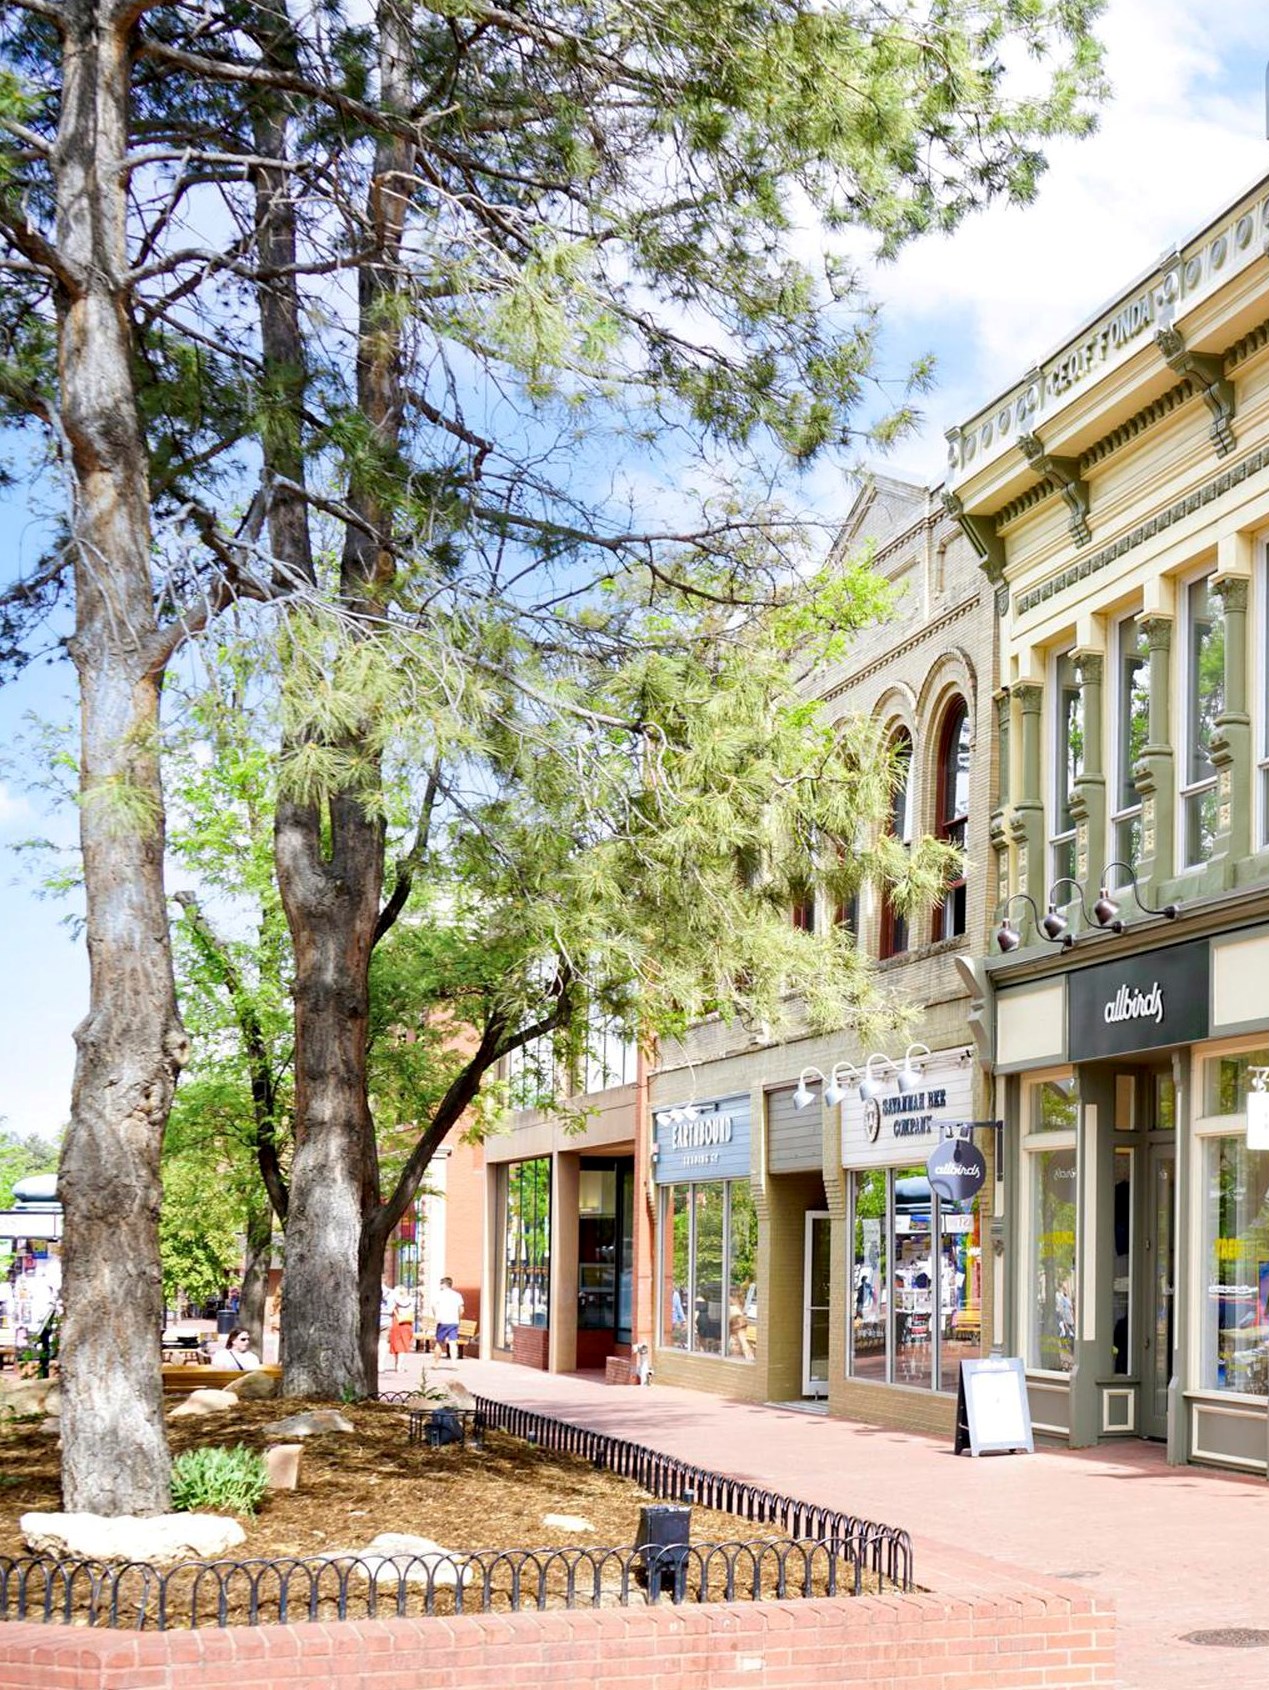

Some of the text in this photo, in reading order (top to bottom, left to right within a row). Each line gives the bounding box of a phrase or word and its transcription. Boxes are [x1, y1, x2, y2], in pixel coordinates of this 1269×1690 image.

[1104, 982, 1163, 1023] allbirds
[882, 1088, 946, 1116] SAVANNAH BEE
[672, 1116, 732, 1150] EARTHBOUND
[893, 1115, 932, 1137] COMPANY
[935, 1162, 980, 1178] allbirds
